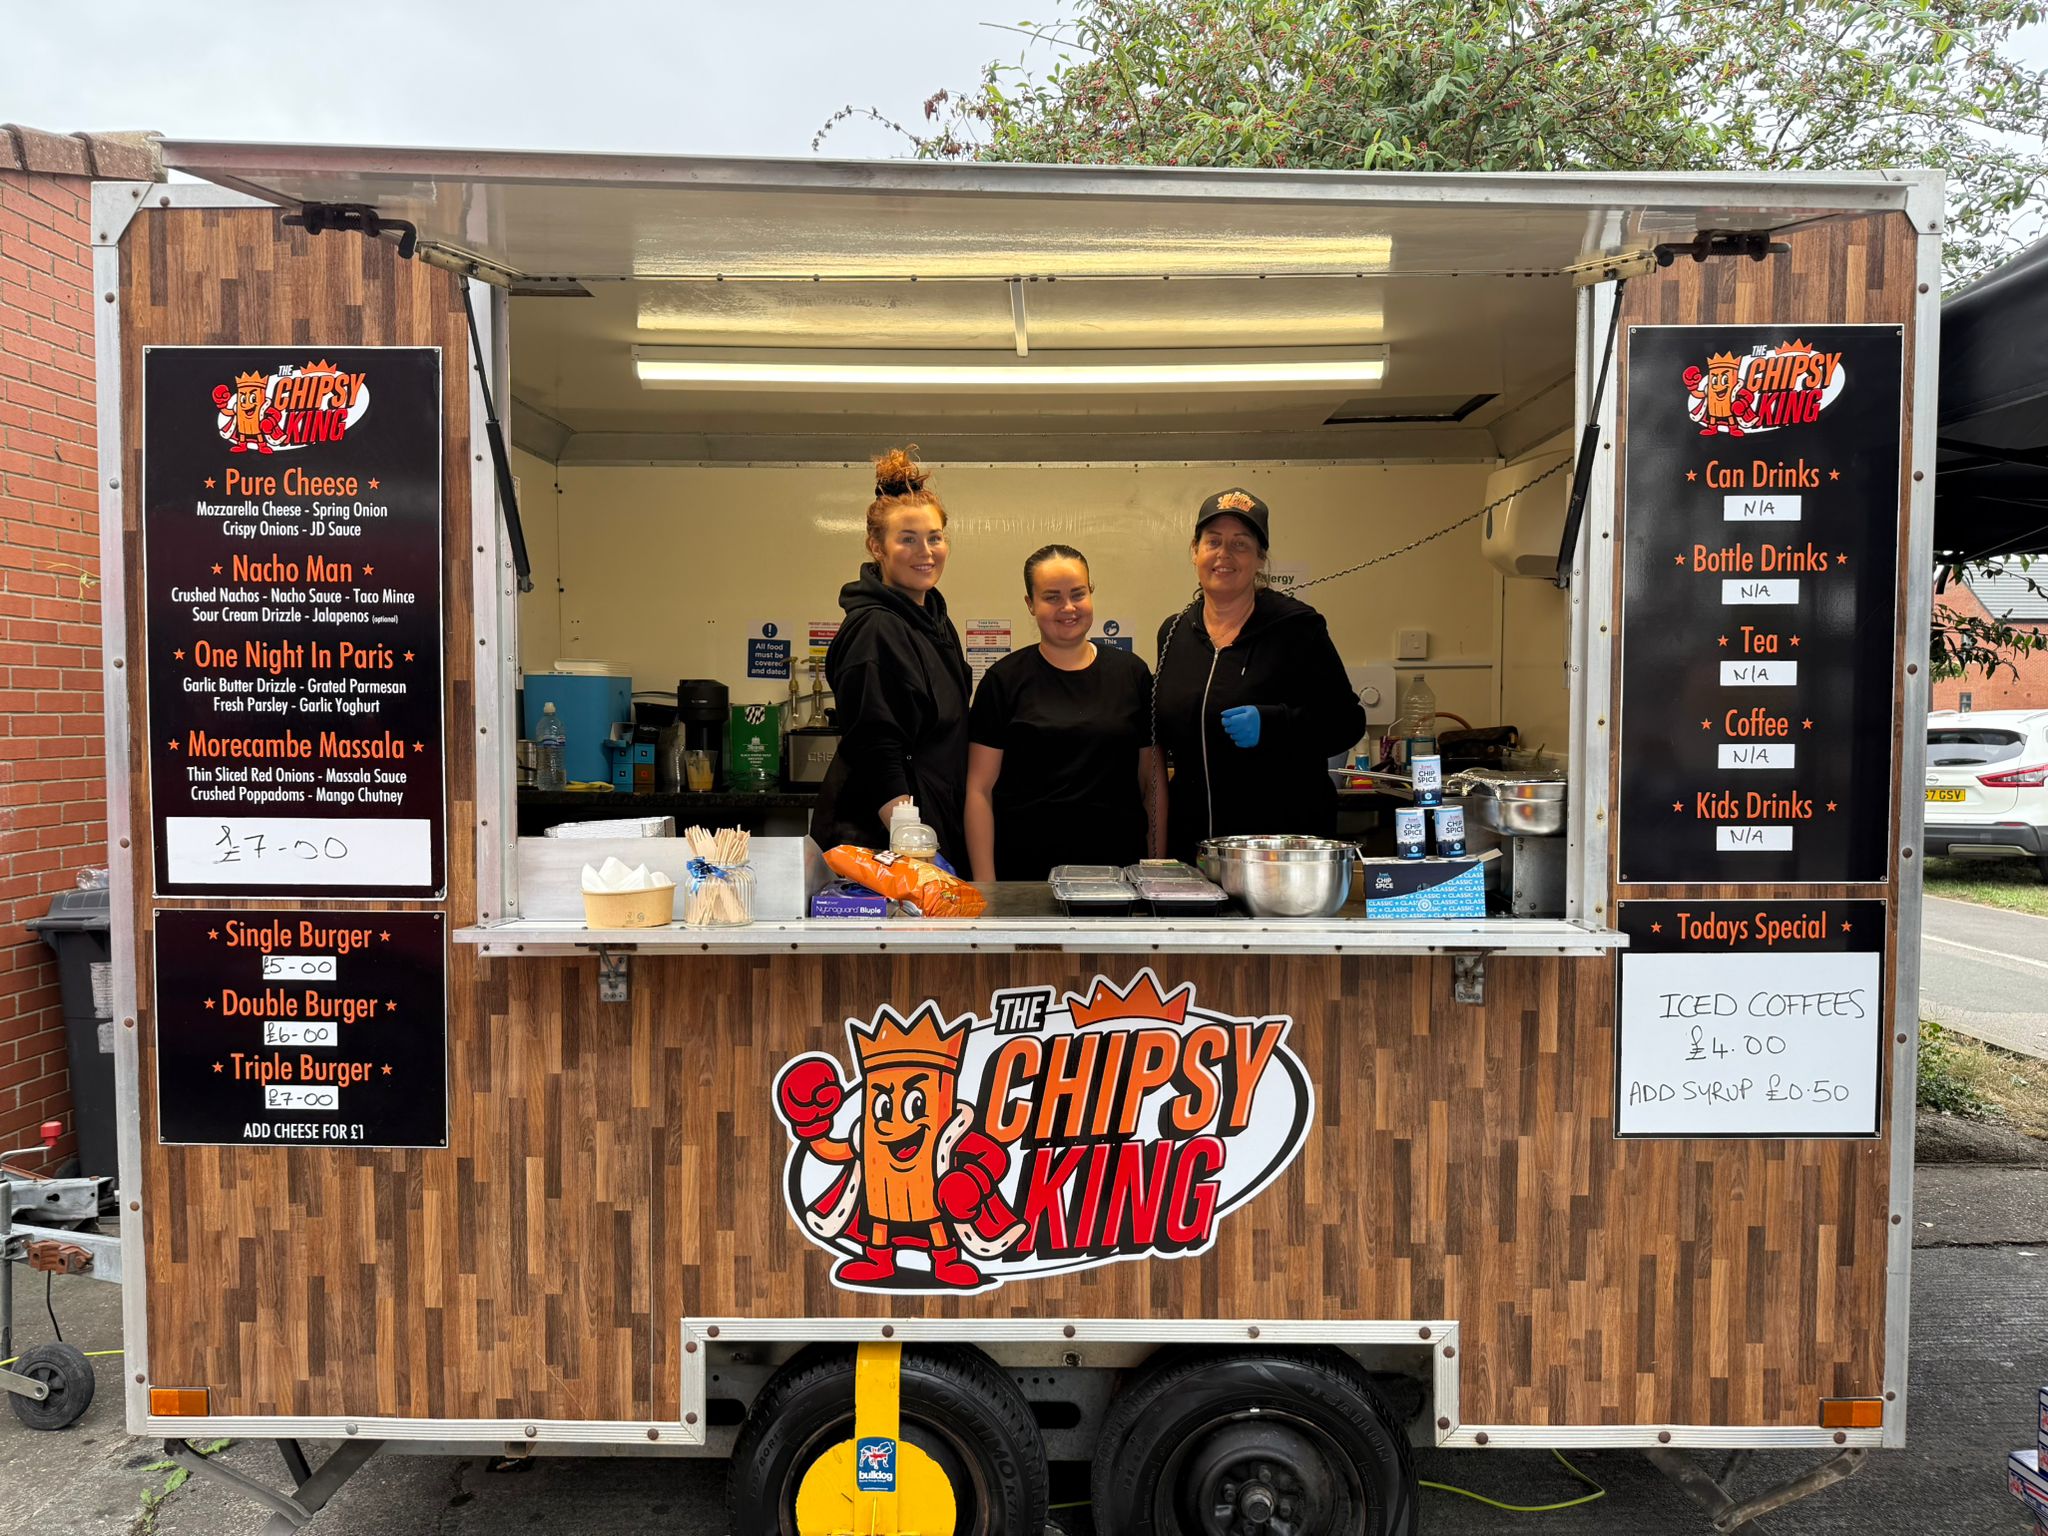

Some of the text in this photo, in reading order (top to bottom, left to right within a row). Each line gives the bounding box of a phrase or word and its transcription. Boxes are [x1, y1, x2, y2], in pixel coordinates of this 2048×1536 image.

[1752, 345, 1767, 356] THE
[278, 365, 293, 376] THE
[1748, 352, 1842, 393] CHIPSY
[275, 373, 366, 410] CHIPSY
[1757, 389, 1822, 427] KING
[286, 409, 348, 444] KING
[225, 467, 358, 497] Pure Cheese
[1706, 459, 1820, 488] Can Drinks
[197, 501, 258, 517] Mozzarella
[262, 501, 301, 517] Cheese
[313, 502, 350, 519] Spring
[353, 502, 387, 517] Onion
[1744, 500, 1775, 516] N/A
[223, 521, 256, 538] Crispy
[260, 521, 299, 536] Onions
[310, 522, 324, 536] JD
[328, 522, 361, 536] Sauce
[233, 554, 352, 583] Nacho Man
[1693, 543, 1828, 572] Bottle Drinks
[172, 587, 216, 602] Crushed
[220, 588, 259, 603] Nachos
[271, 588, 306, 603] Nacho
[309, 589, 341, 604] Sauce
[353, 589, 379, 604] Taco
[382, 589, 415, 604] Mince
[1741, 584, 1771, 598] N/A
[193, 607, 219, 622] Sour
[222, 608, 258, 622] Cream
[262, 608, 301, 623] Drizzle
[312, 609, 369, 625] Jalapenos
[372, 614, 398, 624] (optional)
[1741, 626, 1778, 653] Tea
[195, 640, 393, 675] One Night In Paris
[183, 677, 216, 692] Garlic
[219, 678, 254, 693] Butter
[257, 678, 296, 693] Drizzle
[308, 679, 346, 694] Grated
[350, 680, 406, 694] Parmesan
[1734, 665, 1769, 681] N/A
[214, 698, 243, 712] Fresh
[248, 698, 288, 715] Parsley
[299, 698, 332, 712] Garlic
[335, 699, 380, 714] Yoghurt
[1725, 708, 1788, 737] Coffee
[188, 730, 404, 759] Morecambe Massala
[1733, 749, 1769, 764] N/A
[187, 766, 212, 782] Thin
[215, 767, 247, 782] Sliced
[251, 767, 272, 782] Red
[276, 768, 315, 783] Onions
[326, 768, 371, 783] Massala
[374, 768, 407, 784] Sauce
[191, 786, 236, 801] Crushed
[239, 787, 305, 805] Poppadoms
[316, 788, 354, 805] Mango
[358, 788, 403, 806] Chutney
[1696, 790, 1813, 819] Kids Drinks
[1939, 790, 1961, 799] GSV
[1730, 827, 1763, 844] N/A
[225, 919, 372, 954] Single Burger
[1677, 911, 1826, 945] Todays Special
[222, 988, 377, 1024] Double Burger
[999, 996, 1046, 1031] THE
[1659, 989, 1865, 1019] ICED COFFEES
[1685, 1025, 1786, 1060] £4.00
[231, 1052, 372, 1087] Triple Burger
[986, 1021, 1285, 1144] CHIPSY
[1629, 1081, 1675, 1106] ADD
[1682, 1079, 1753, 1105] SYRUP
[244, 1123, 364, 1139] ADD CHEESE FOR £1
[1017, 1136, 1227, 1252] KING
[859, 1471, 893, 1481] bulldog
